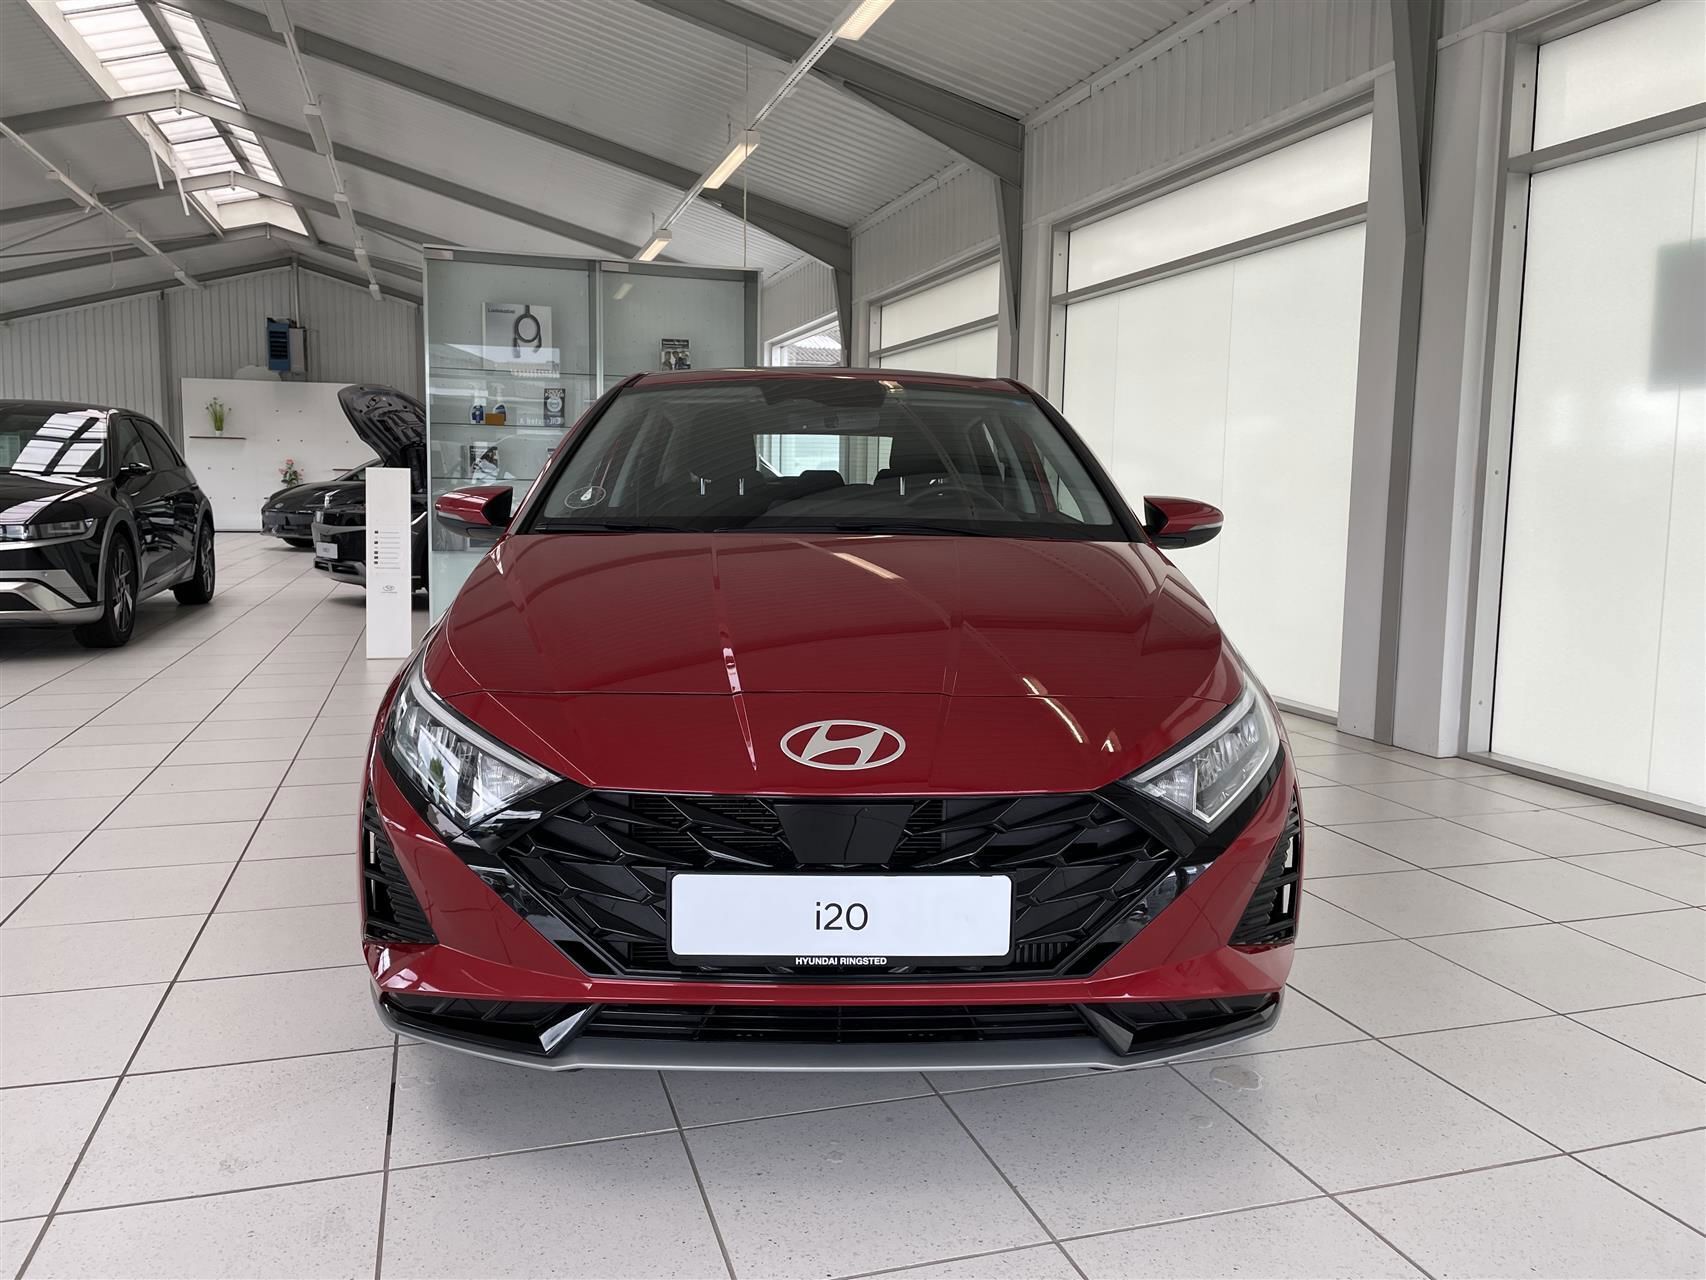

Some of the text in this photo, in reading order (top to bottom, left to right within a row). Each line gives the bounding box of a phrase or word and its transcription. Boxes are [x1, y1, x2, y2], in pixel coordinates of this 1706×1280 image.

[815, 901, 869, 931] i20
[795, 957, 887, 965] HYUNDAI RINGSTED
